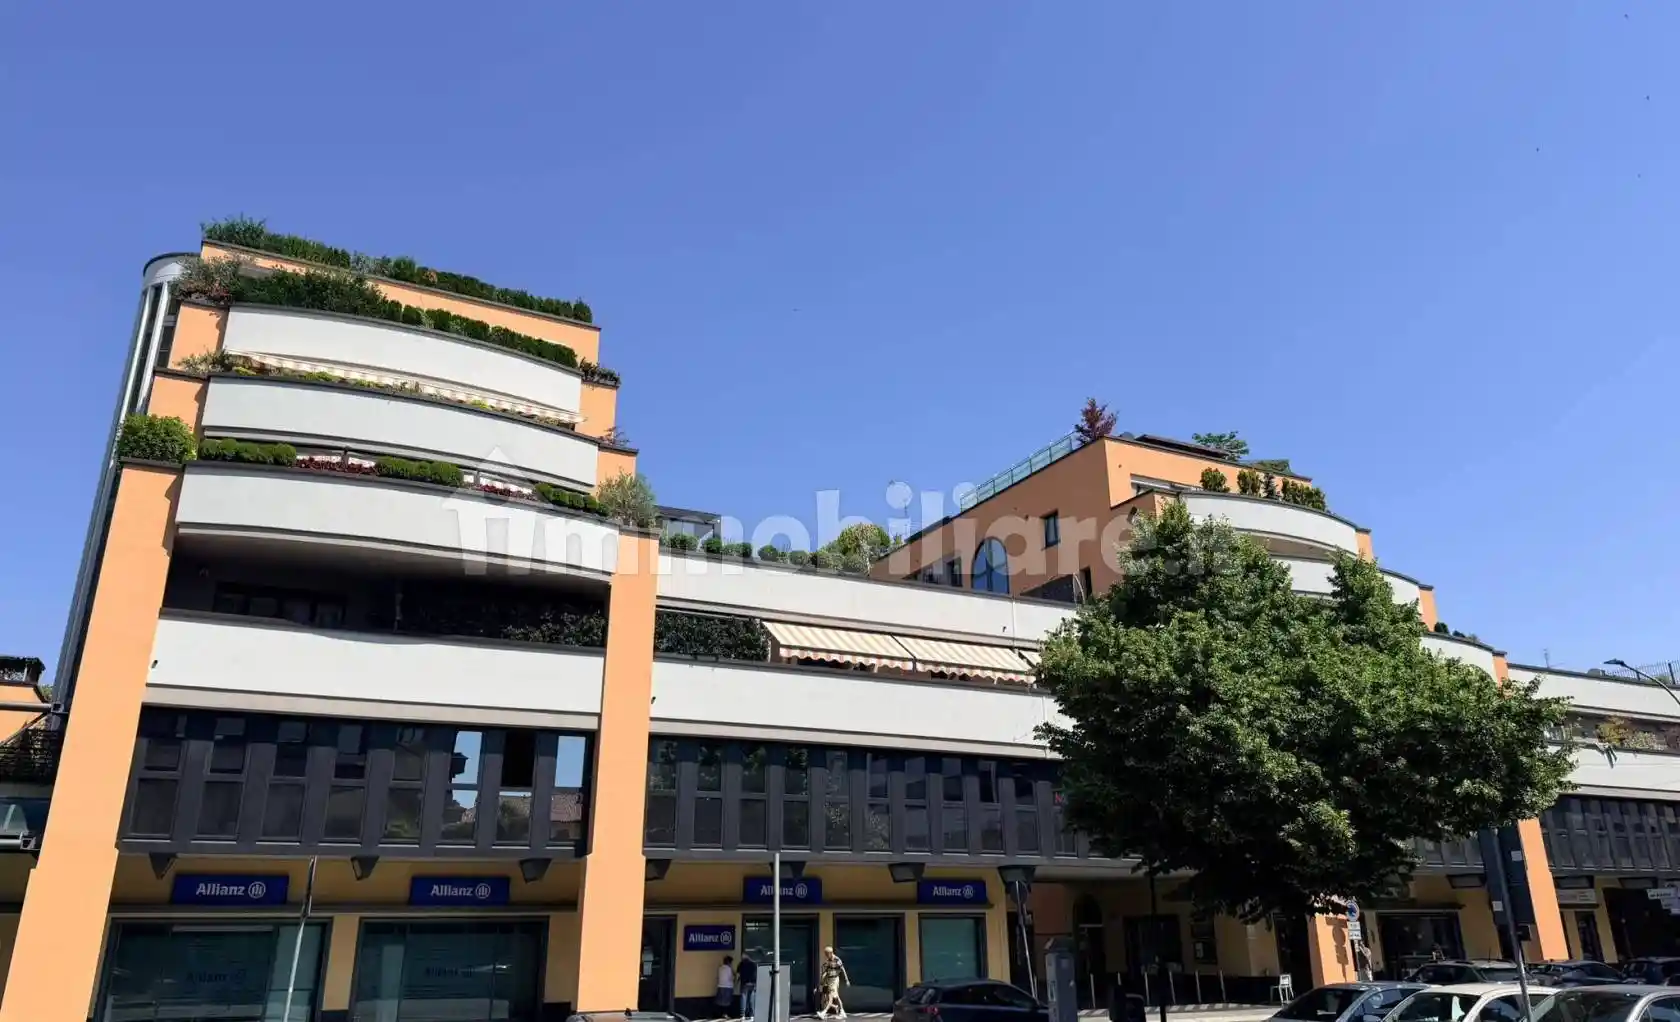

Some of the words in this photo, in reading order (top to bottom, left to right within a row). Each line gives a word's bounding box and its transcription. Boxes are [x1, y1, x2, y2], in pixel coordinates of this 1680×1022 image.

[196, 883, 245, 896] Allianz
[430, 884, 473, 896] Allianz
[760, 884, 794, 896] Allanz
[932, 886, 961, 896] Allianz
[688, 933, 719, 943] Allianz
